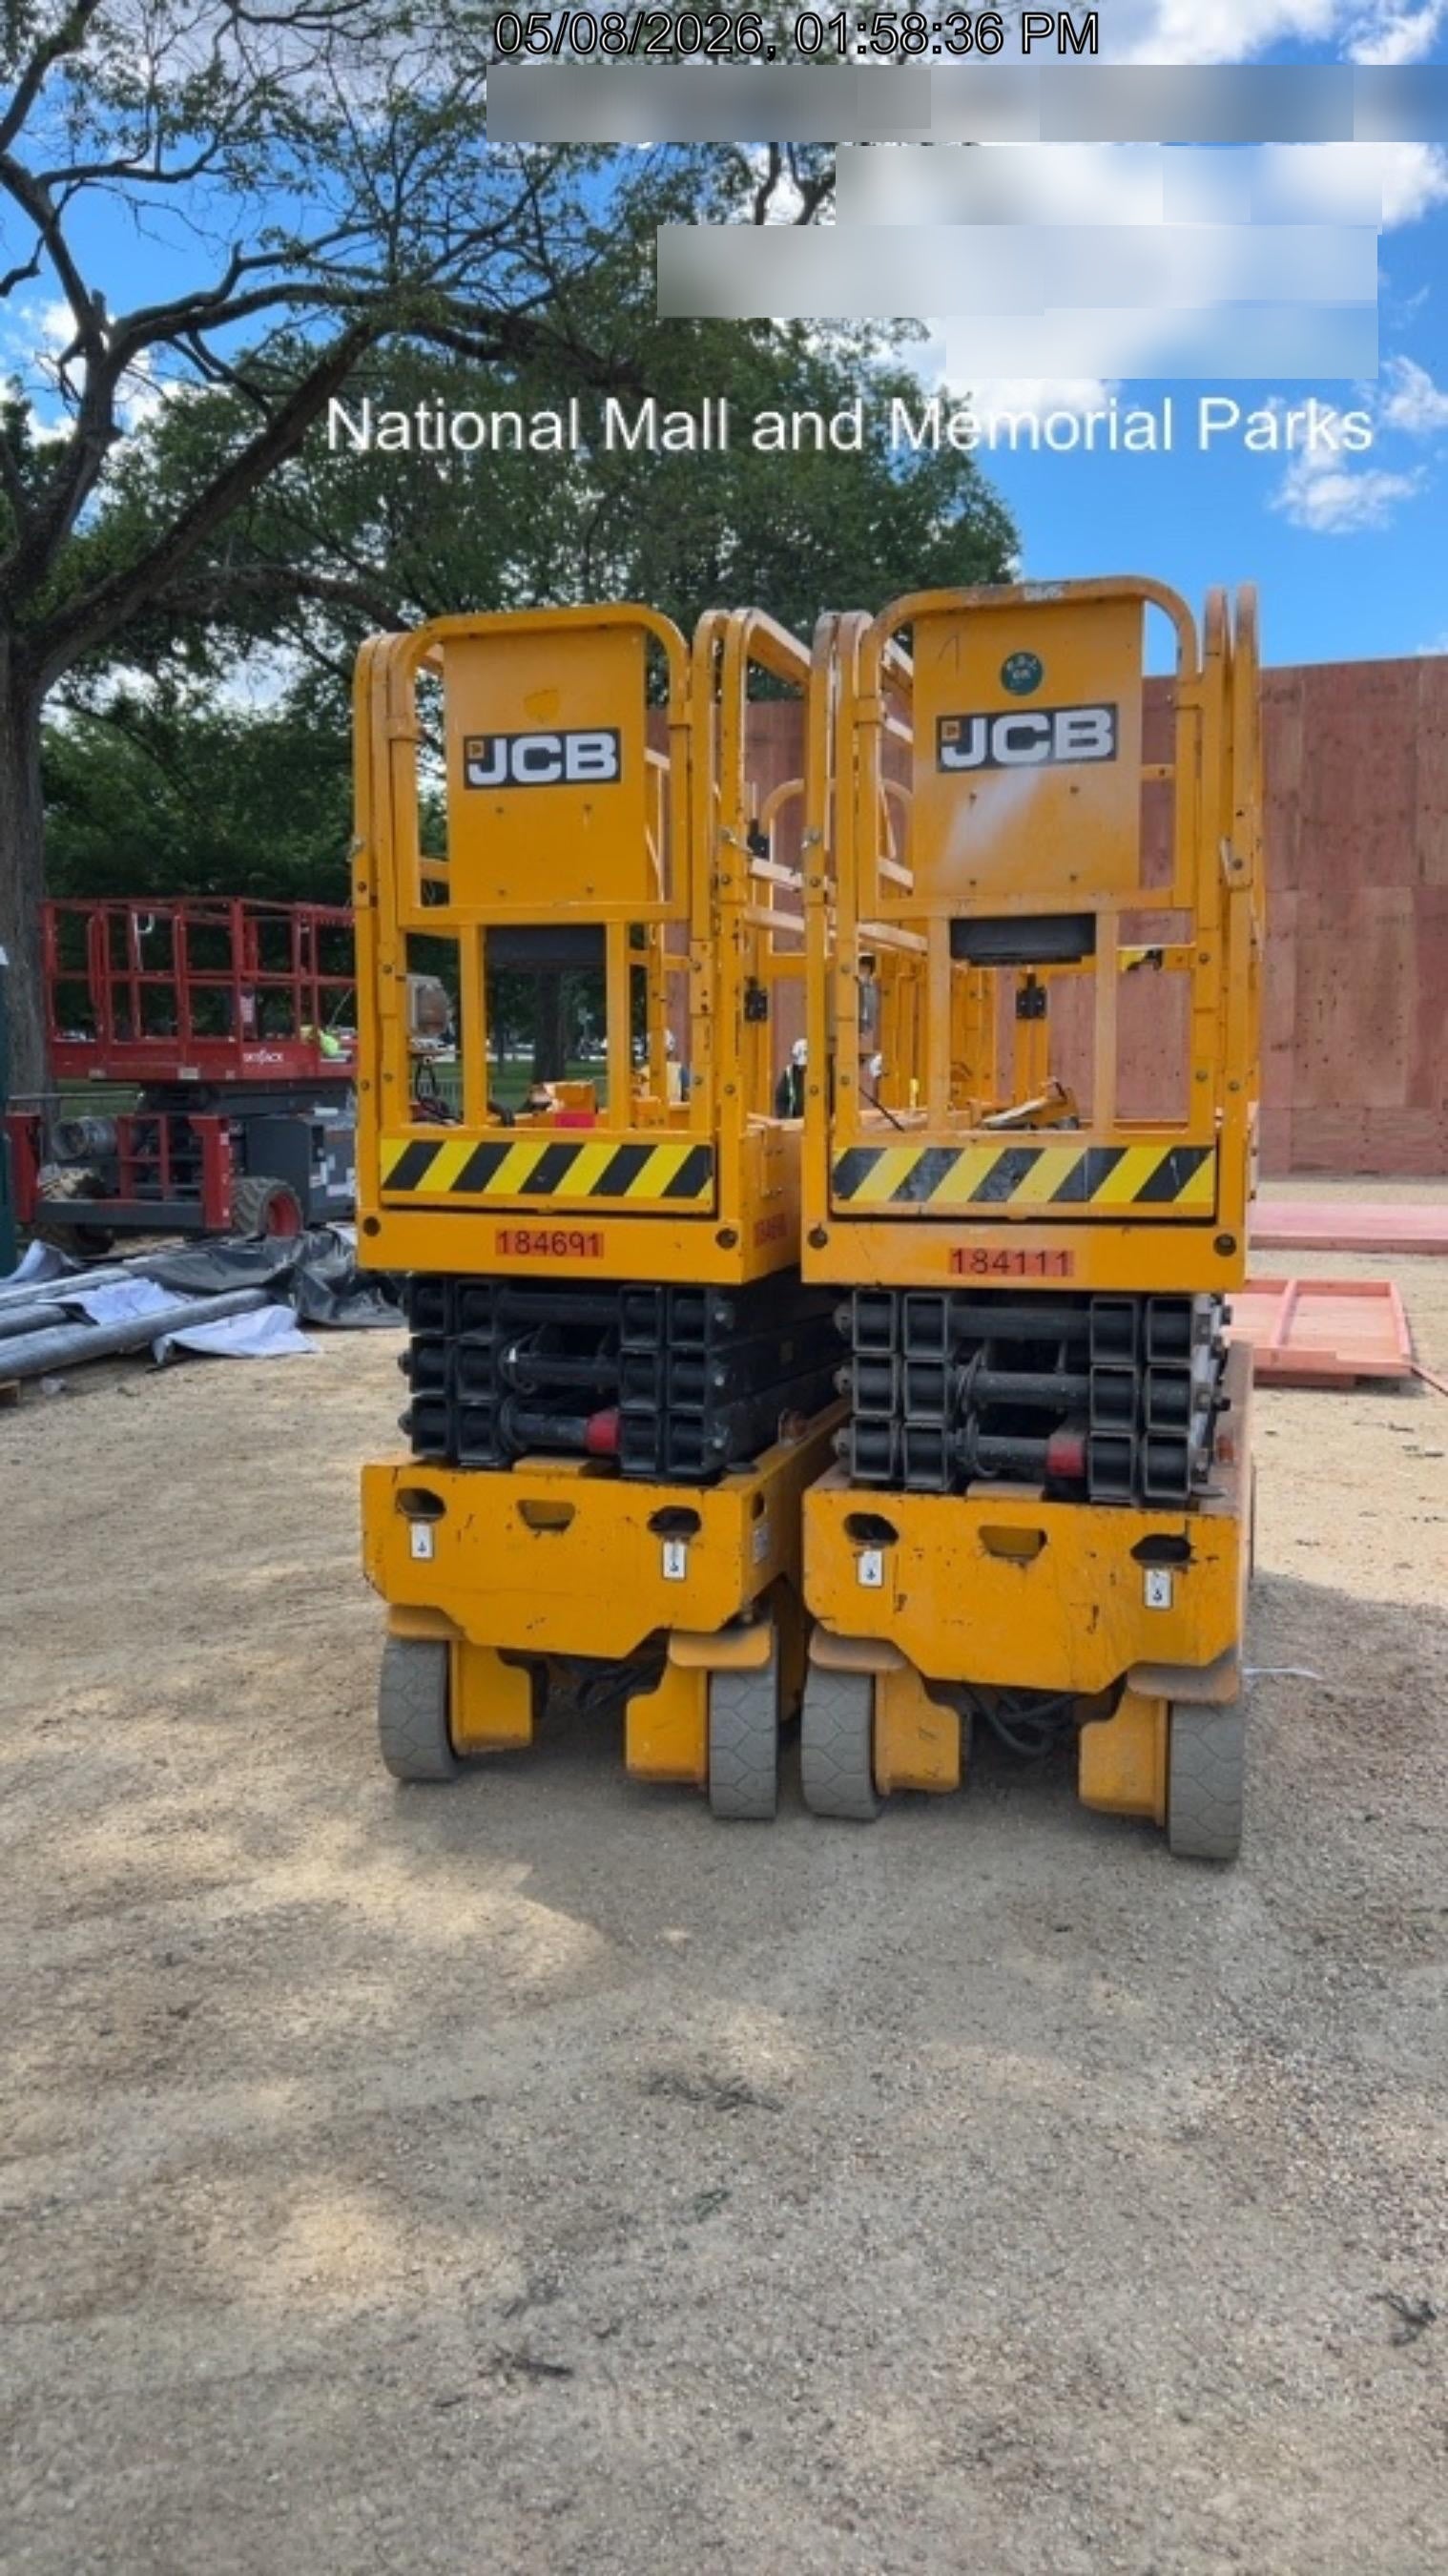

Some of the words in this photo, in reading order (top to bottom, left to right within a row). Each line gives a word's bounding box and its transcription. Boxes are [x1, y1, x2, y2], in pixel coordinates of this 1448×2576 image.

[467, 732, 618, 786] JCB
[941, 709, 1114, 769] JCB
[498, 1229, 600, 1257] 184691
[952, 1247, 1069, 1277] 184111
